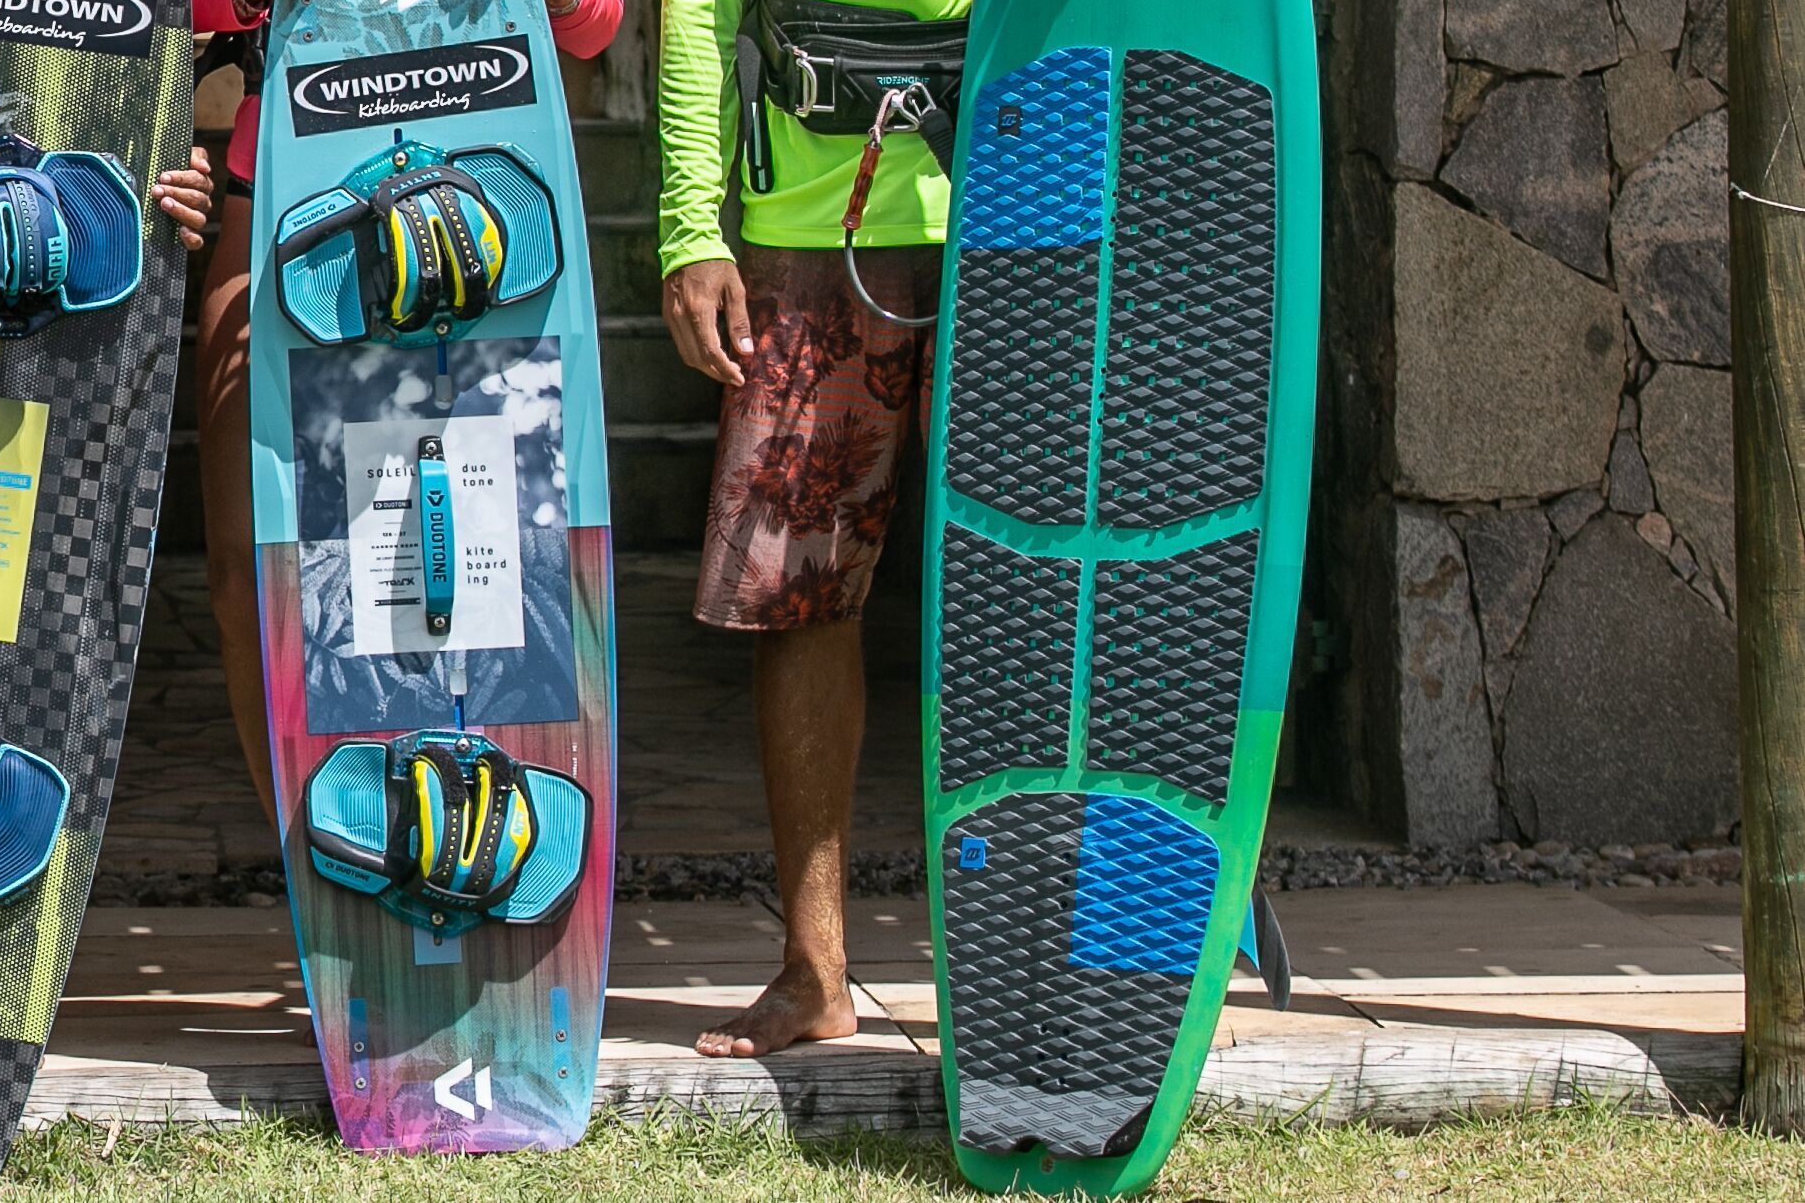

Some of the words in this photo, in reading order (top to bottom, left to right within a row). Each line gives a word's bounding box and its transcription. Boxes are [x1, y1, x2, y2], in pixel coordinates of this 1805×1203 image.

[319, 59, 502, 102] WINDTOWN
[367, 467, 416, 479] SOLEIL
[462, 463, 487, 473] duo
[463, 478, 494, 487] tone
[429, 512, 447, 583] DUOTONE
[466, 546, 494, 556] kite
[467, 559, 507, 570] board
[467, 575, 489, 586] ing
